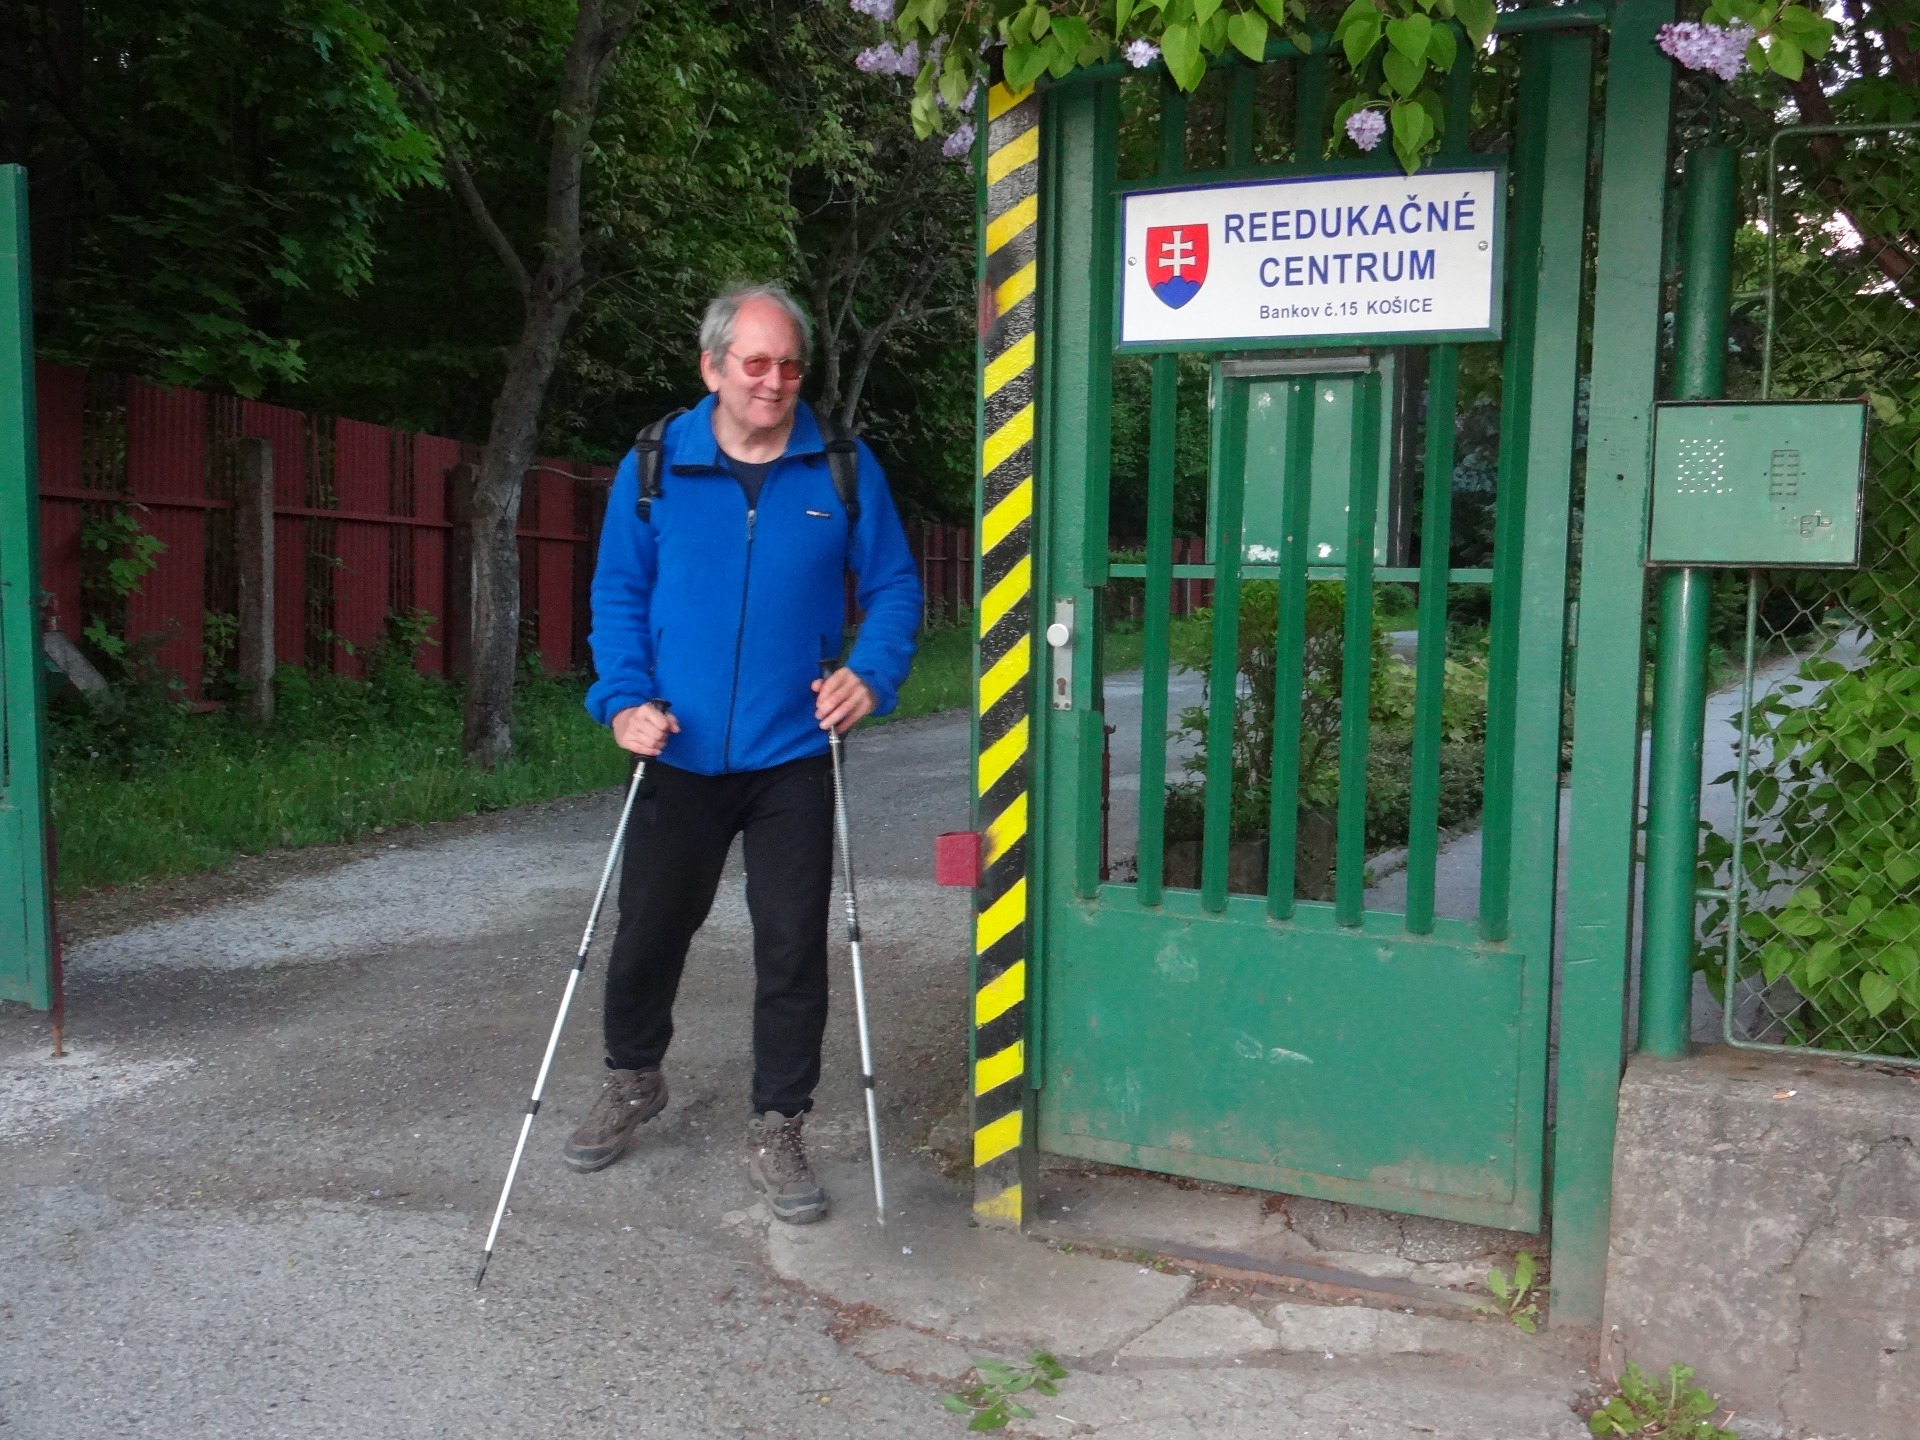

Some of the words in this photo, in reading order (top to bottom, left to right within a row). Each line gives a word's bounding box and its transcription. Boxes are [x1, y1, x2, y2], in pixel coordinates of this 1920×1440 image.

[1224, 191, 1476, 244] REEDUKAČNÉ
[1259, 249, 1436, 288] CENTRUM
[1259, 304, 1320, 320] Bankov
[1324, 301, 1358, 317] č.15
[1367, 295, 1433, 315] KOŠICE
